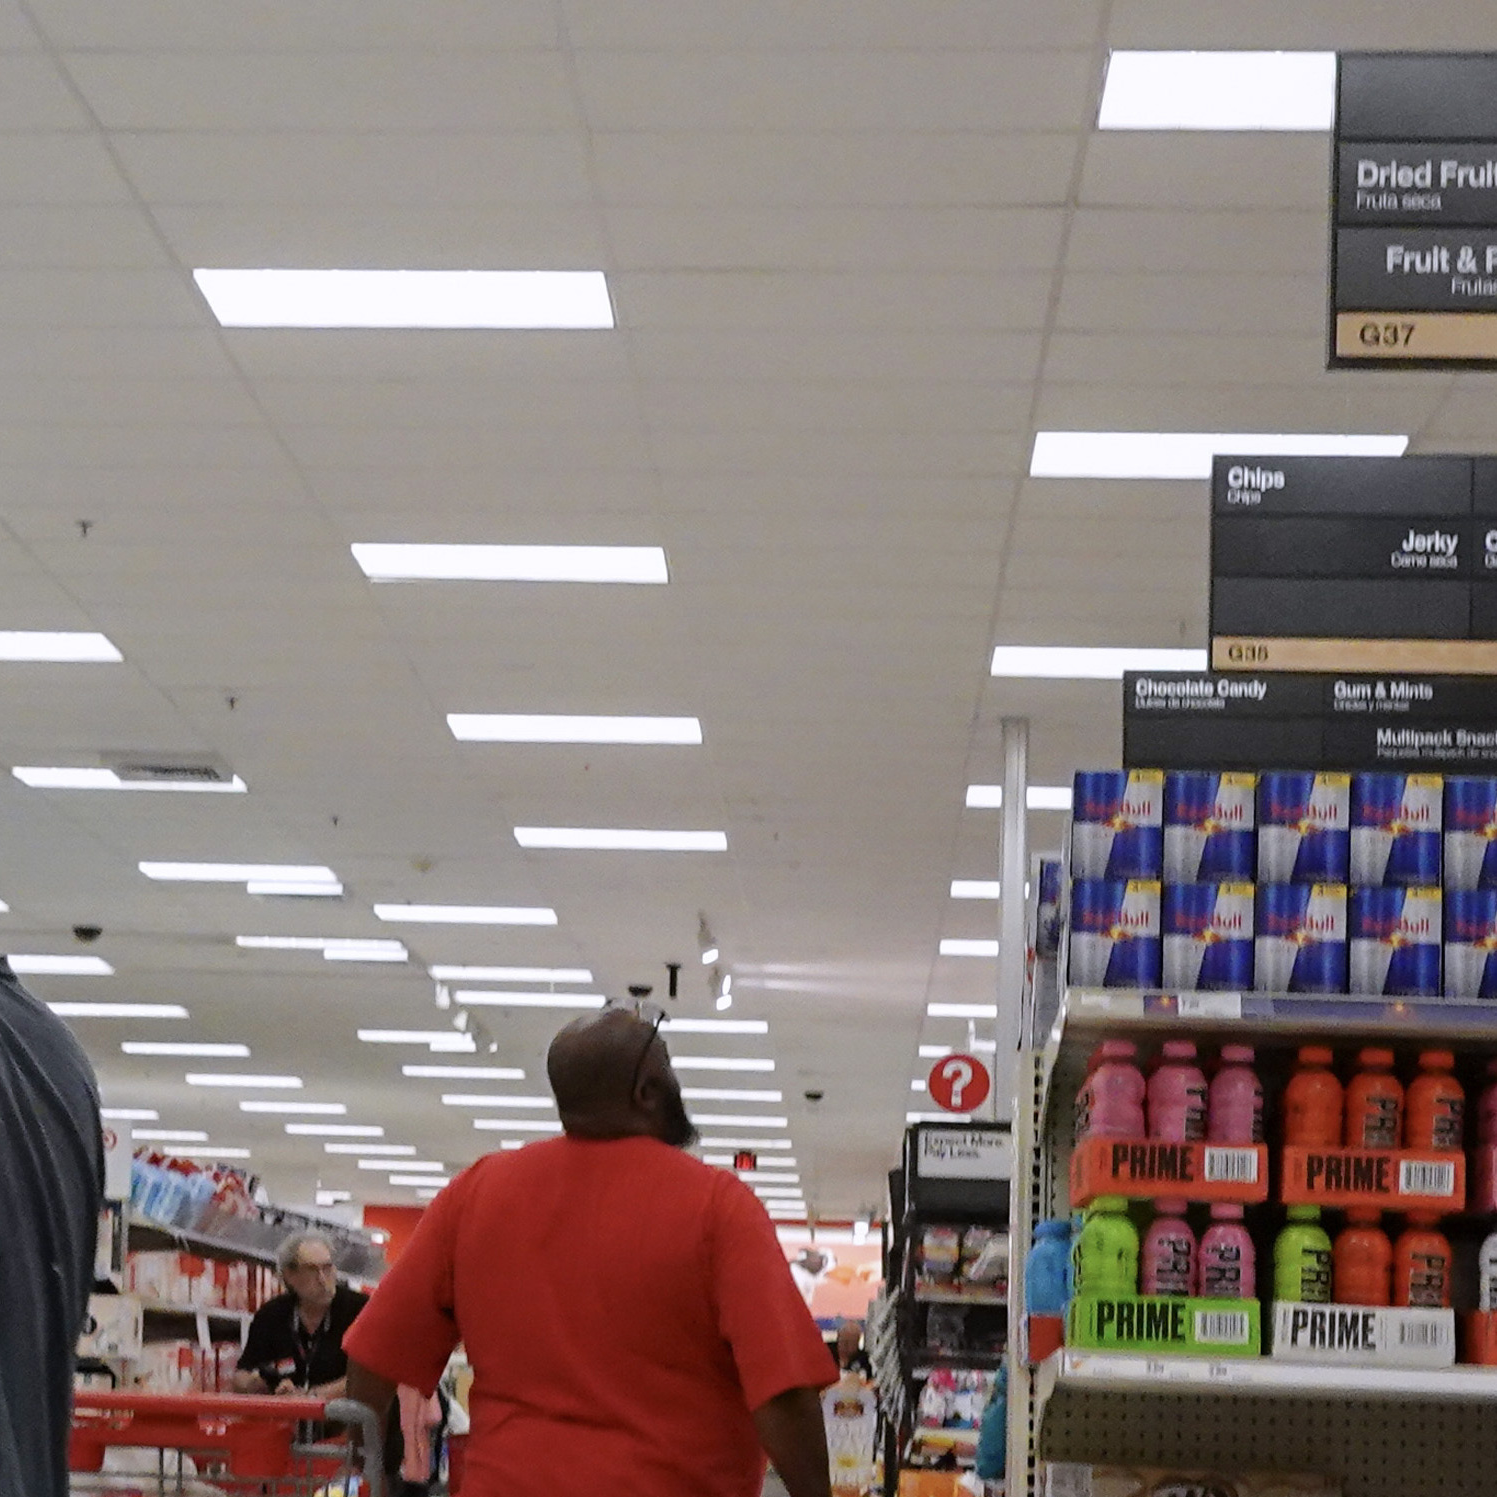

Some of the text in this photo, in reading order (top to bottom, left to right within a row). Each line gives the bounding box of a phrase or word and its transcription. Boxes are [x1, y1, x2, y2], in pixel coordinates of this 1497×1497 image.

[1357, 160, 1432, 188] Dried
[1387, 246, 1450, 273] Fruit
[1456, 247, 1478, 273] &
[1228, 465, 1285, 492] Chips
[1402, 529, 1459, 556] Jerky
[1217, 678, 1267, 701] Candy
[1112, 1144, 1193, 1182] PRIME
[1307, 1155, 1391, 1193] PRIME
[1096, 1301, 1187, 1342] PRIME
[1291, 1310, 1377, 1350] PRIME
